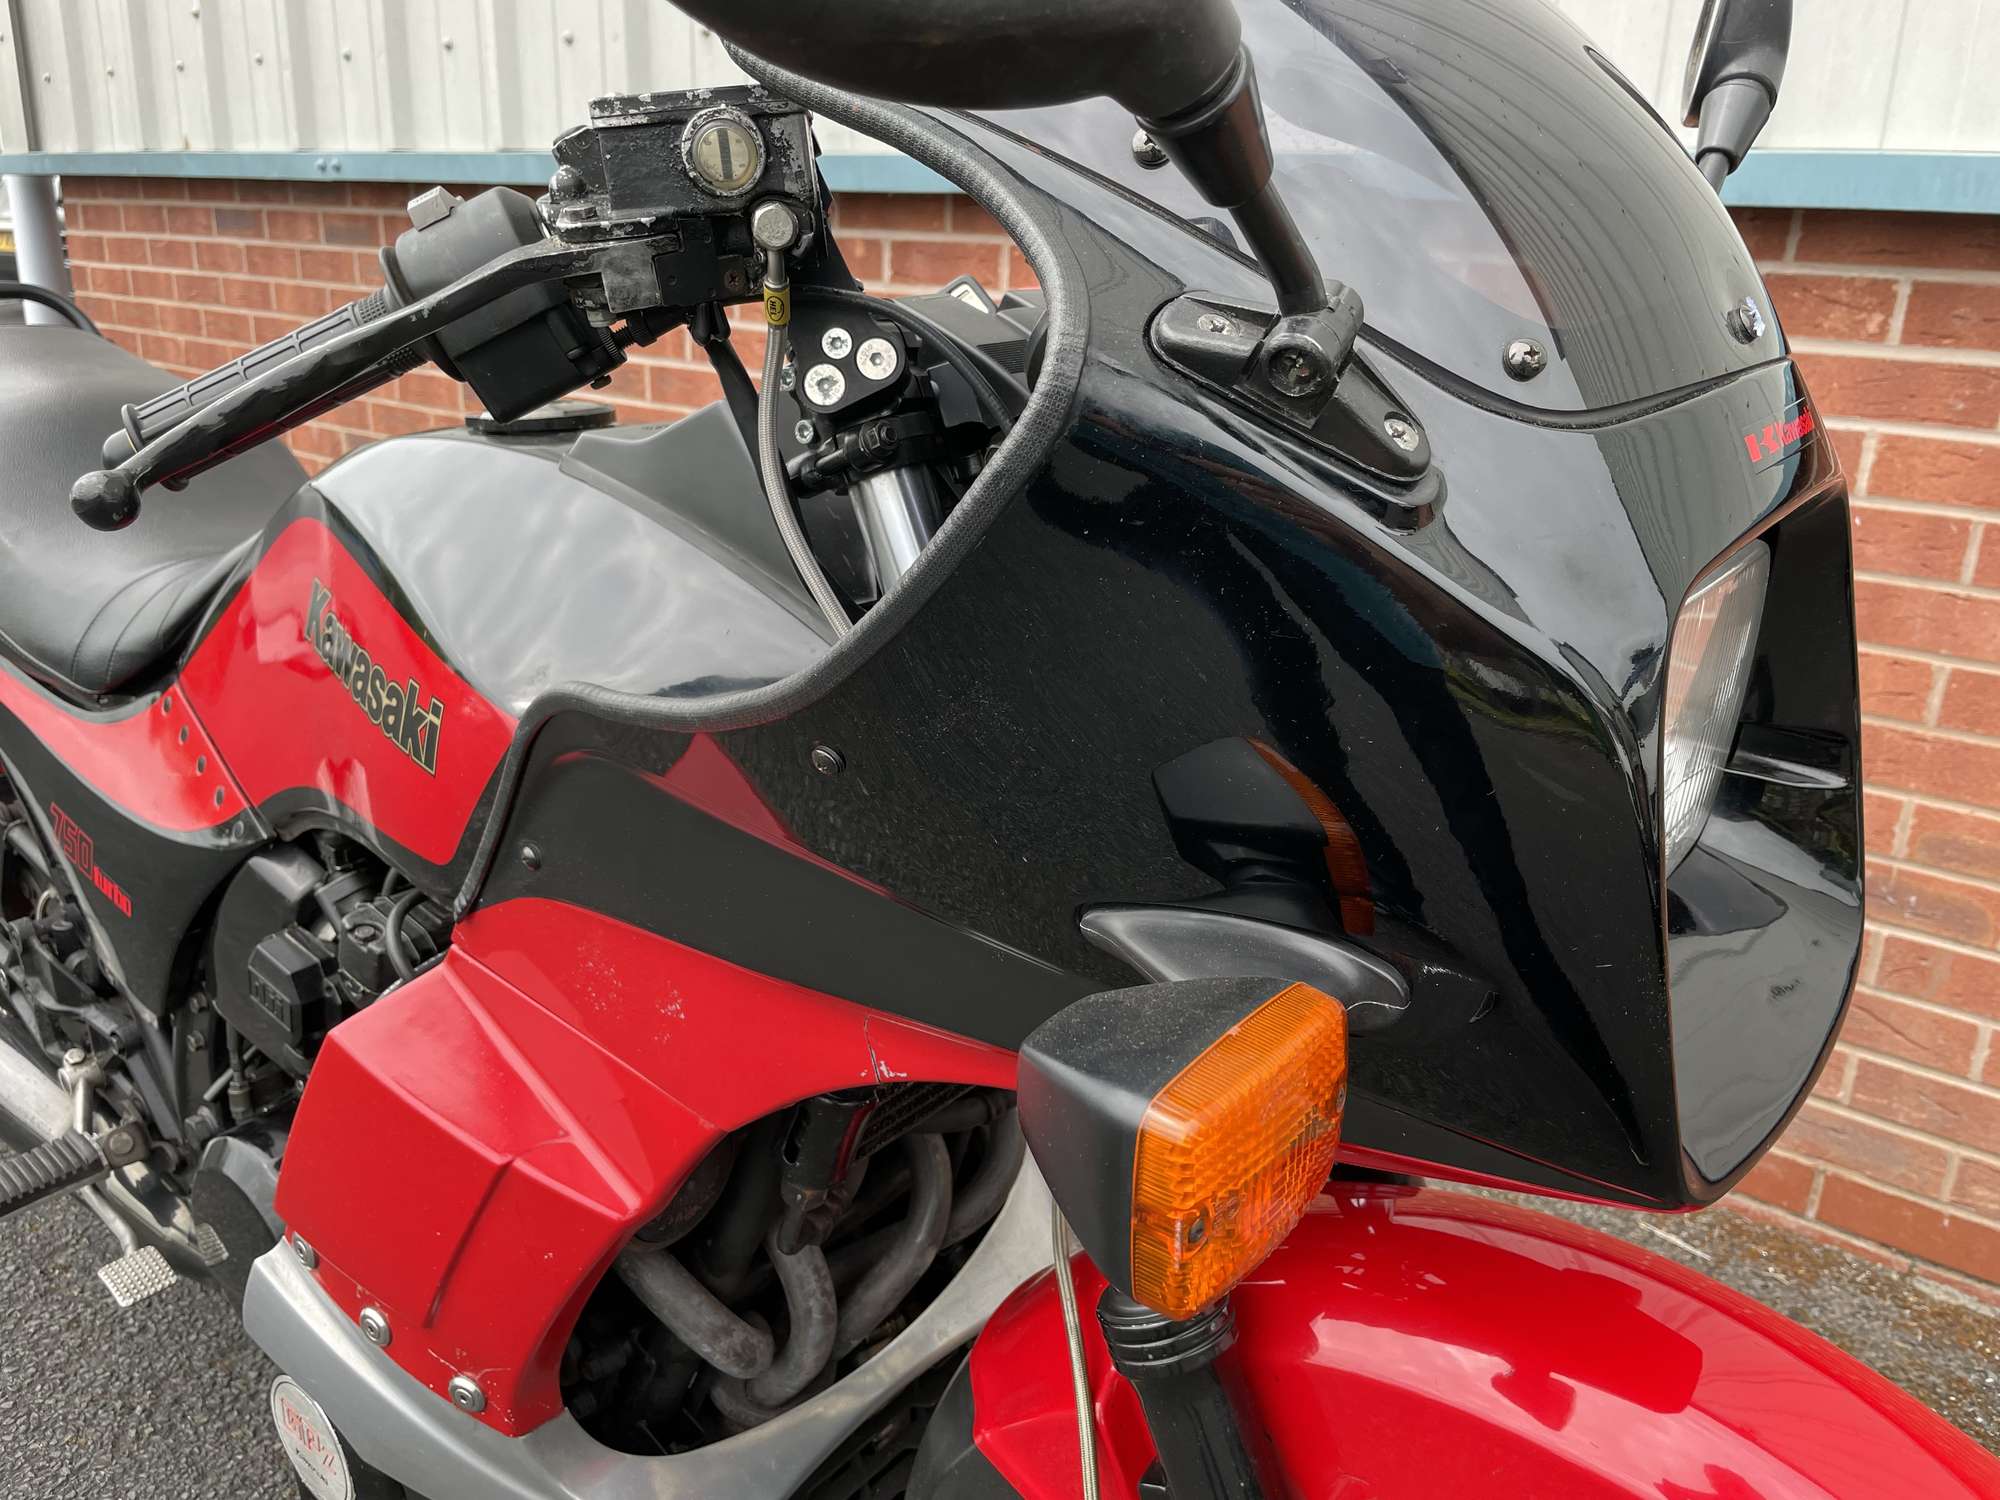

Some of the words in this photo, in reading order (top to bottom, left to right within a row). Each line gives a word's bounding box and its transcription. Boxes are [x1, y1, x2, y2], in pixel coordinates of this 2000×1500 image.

[305, 578, 444, 776] Kawasaki
[50, 802, 94, 881] 750
[93, 864, 133, 919] turbo
